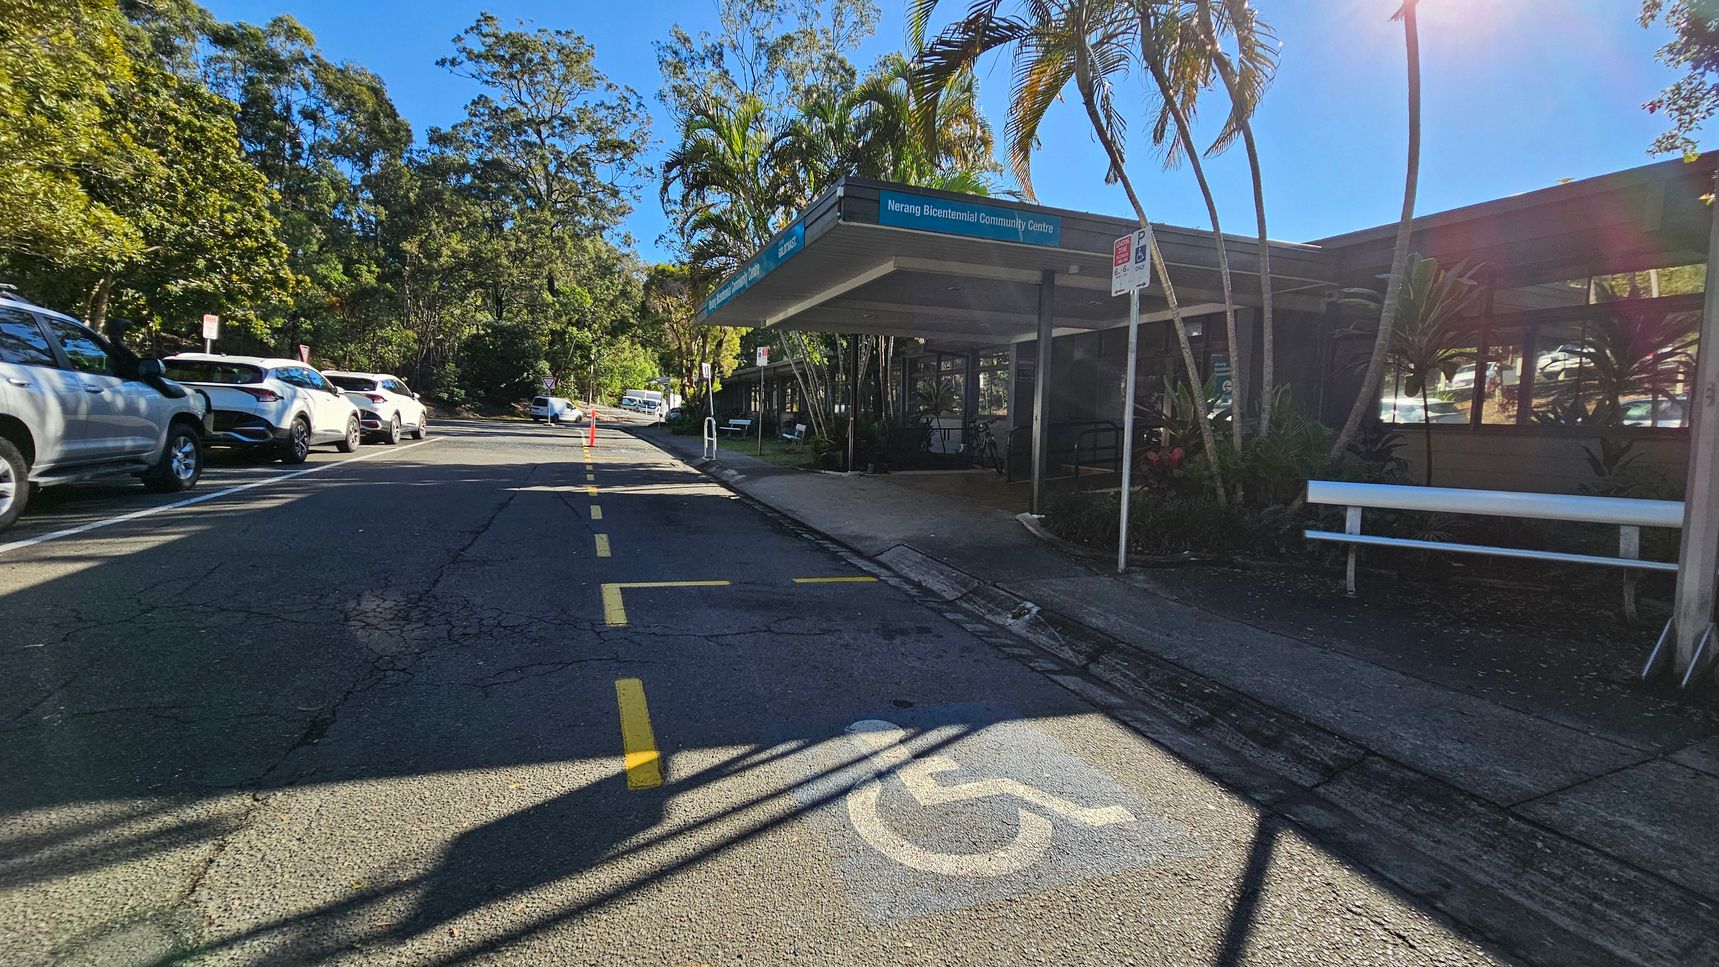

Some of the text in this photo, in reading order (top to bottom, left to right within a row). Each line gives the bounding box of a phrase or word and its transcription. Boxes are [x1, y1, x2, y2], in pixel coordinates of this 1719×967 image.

[887, 199, 1054, 234] Nerang Bicentennial Community Centre
[1137, 231, 1146, 246] P
